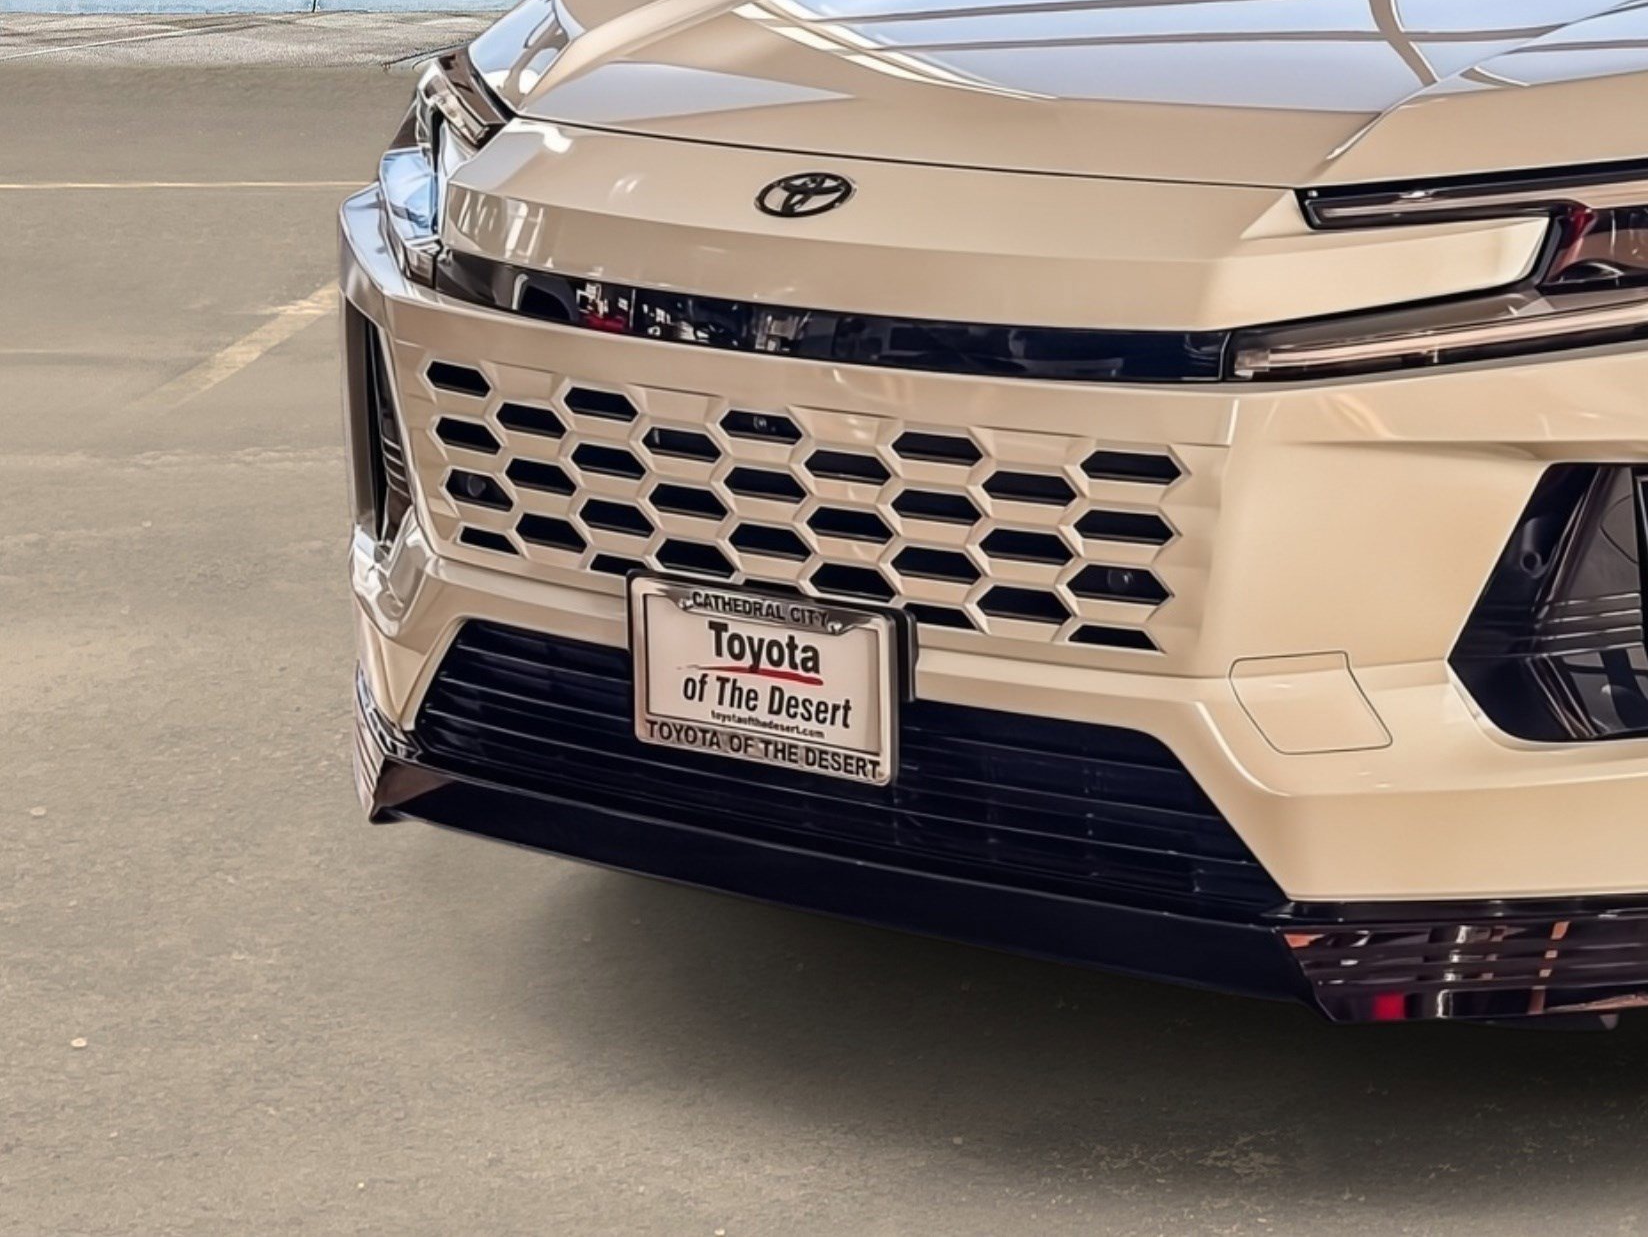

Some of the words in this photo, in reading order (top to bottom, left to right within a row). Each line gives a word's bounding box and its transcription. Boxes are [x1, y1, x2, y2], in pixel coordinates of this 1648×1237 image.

[691, 591, 786, 621] CATHEDRAL
[789, 607, 829, 628] CITY
[708, 621, 820, 674] Toyota
[682, 674, 709, 703] of
[716, 676, 759, 712] The
[768, 686, 852, 729] Desert
[646, 721, 722, 750] TOYOTA
[729, 735, 752, 755] OF
[760, 740, 800, 764] THE
[804, 749, 881, 780] DESERT
